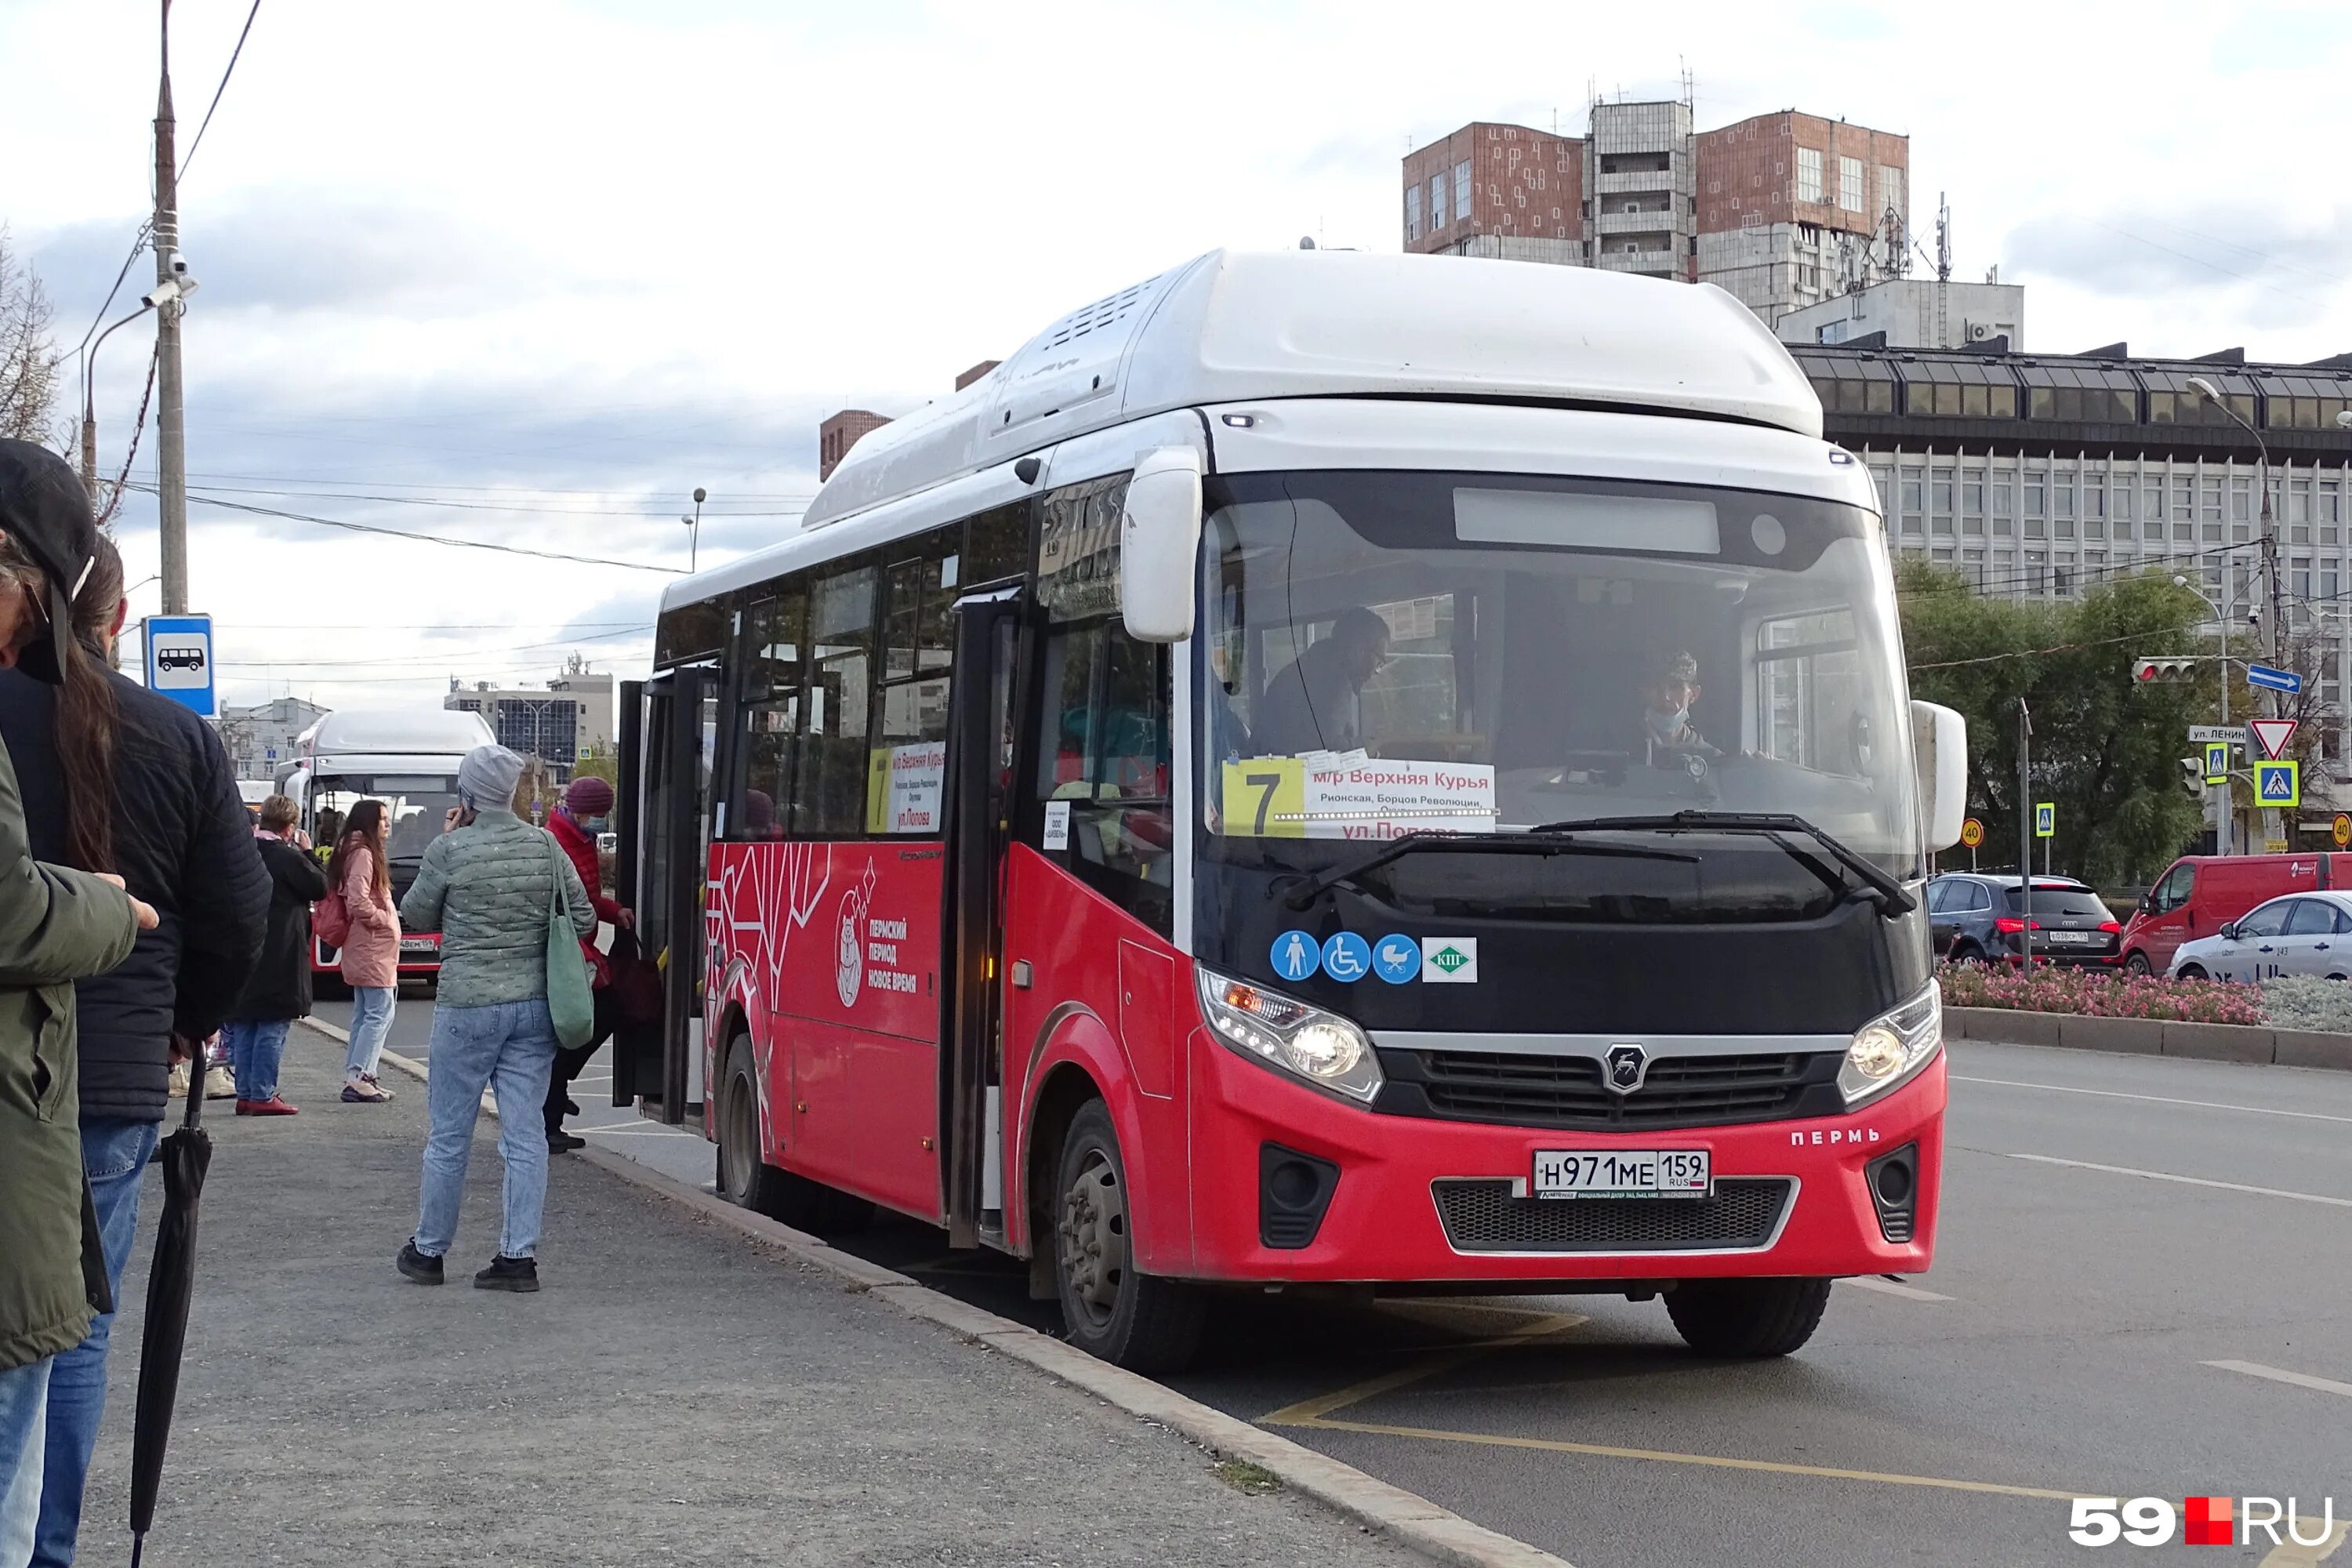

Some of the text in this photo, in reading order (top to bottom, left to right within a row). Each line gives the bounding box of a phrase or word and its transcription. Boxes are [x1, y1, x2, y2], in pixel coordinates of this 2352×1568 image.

[2211, 729, 2245, 739] ЛЕНИН
[1313, 770, 1489, 790] м/р Верхняя Курья
[1246, 773, 1281, 835] 7
[1320, 793, 1374, 804] Рионская,
[1377, 793, 1417, 805] Борцов
[1420, 795, 1483, 809] Революции,
[1342, 822, 1458, 840] ул.Поп
[1965, 827, 1979, 839] 40
[2336, 824, 2348, 837] 40
[869, 917, 907, 941] ПЕРМСКИЙ
[869, 942, 897, 967] ПЕРИОД
[1437, 954, 1464, 966] КПГ
[2276, 946, 2288, 956] 143
[868, 968, 916, 994] НОВОЕ ВРЕМЯ
[1791, 1128, 1880, 1146] ПЕРМЬ
[1544, 1155, 1702, 1185] Н971МЕ 159
[1669, 1178, 1689, 1186] RUS
